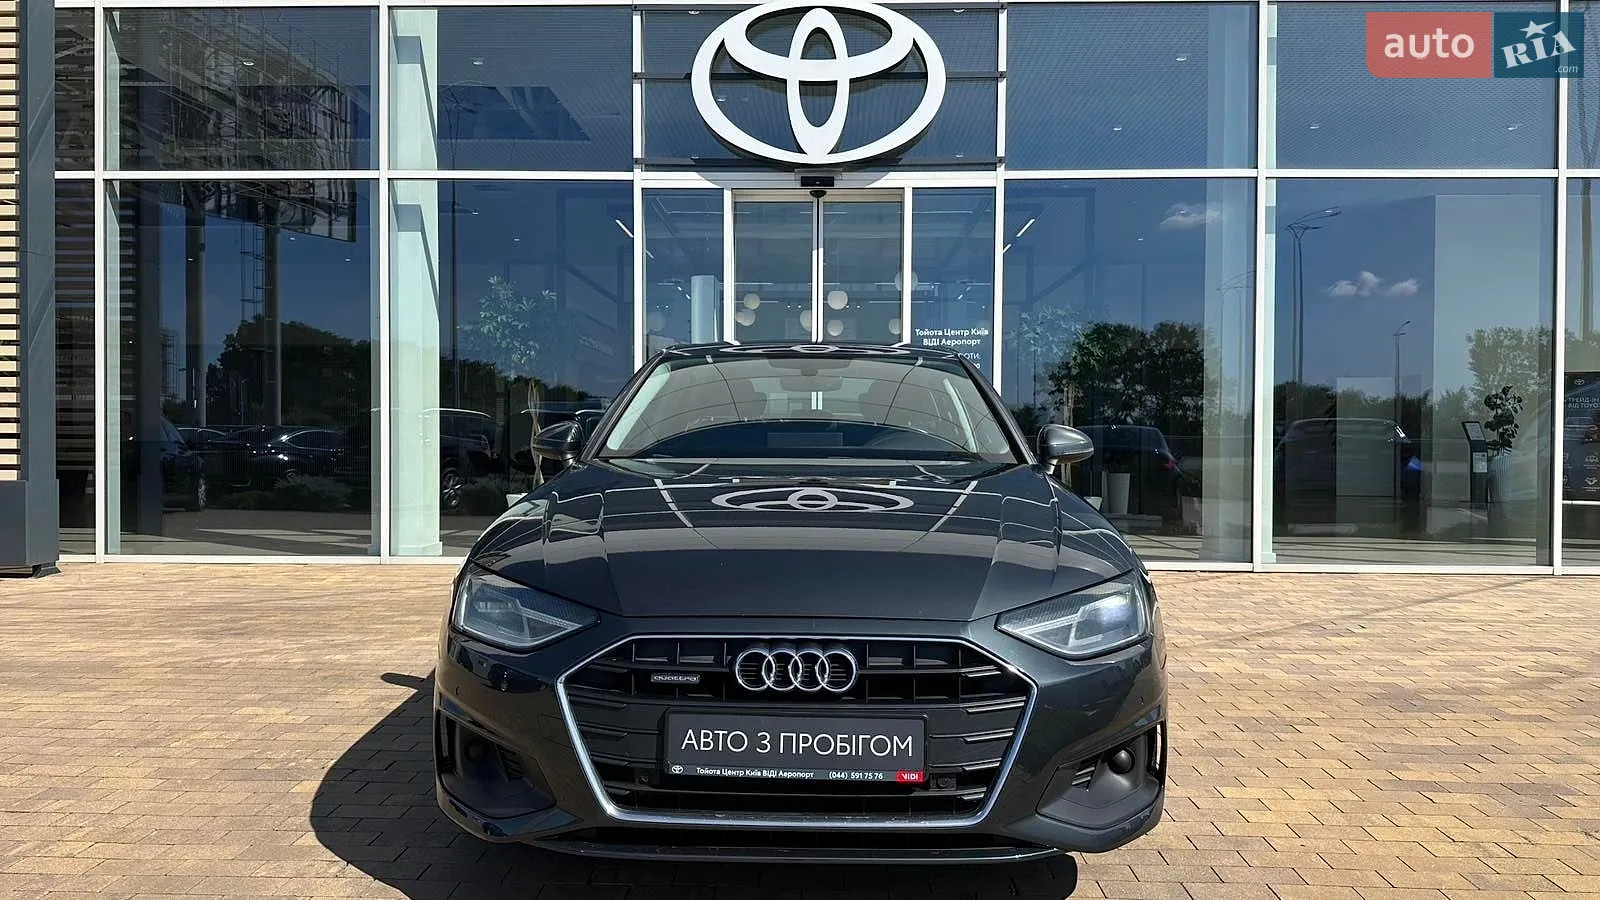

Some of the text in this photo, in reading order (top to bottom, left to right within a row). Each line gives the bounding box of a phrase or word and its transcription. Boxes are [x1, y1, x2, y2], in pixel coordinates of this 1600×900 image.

[915, 328, 989, 337] Тойота Центр Київ
[941, 339, 981, 347] Аеропорт
[681, 729, 748, 751] АВТО
[779, 732, 913, 757] ПРОБІГОМ
[696, 767, 721, 775] Тойота
[722, 768, 744, 777] Центр
[745, 769, 761, 777] Київ
[778, 771, 814, 779] Аеропорт
[829, 771, 848, 780] (044)
[874, 772, 883, 780] 76
